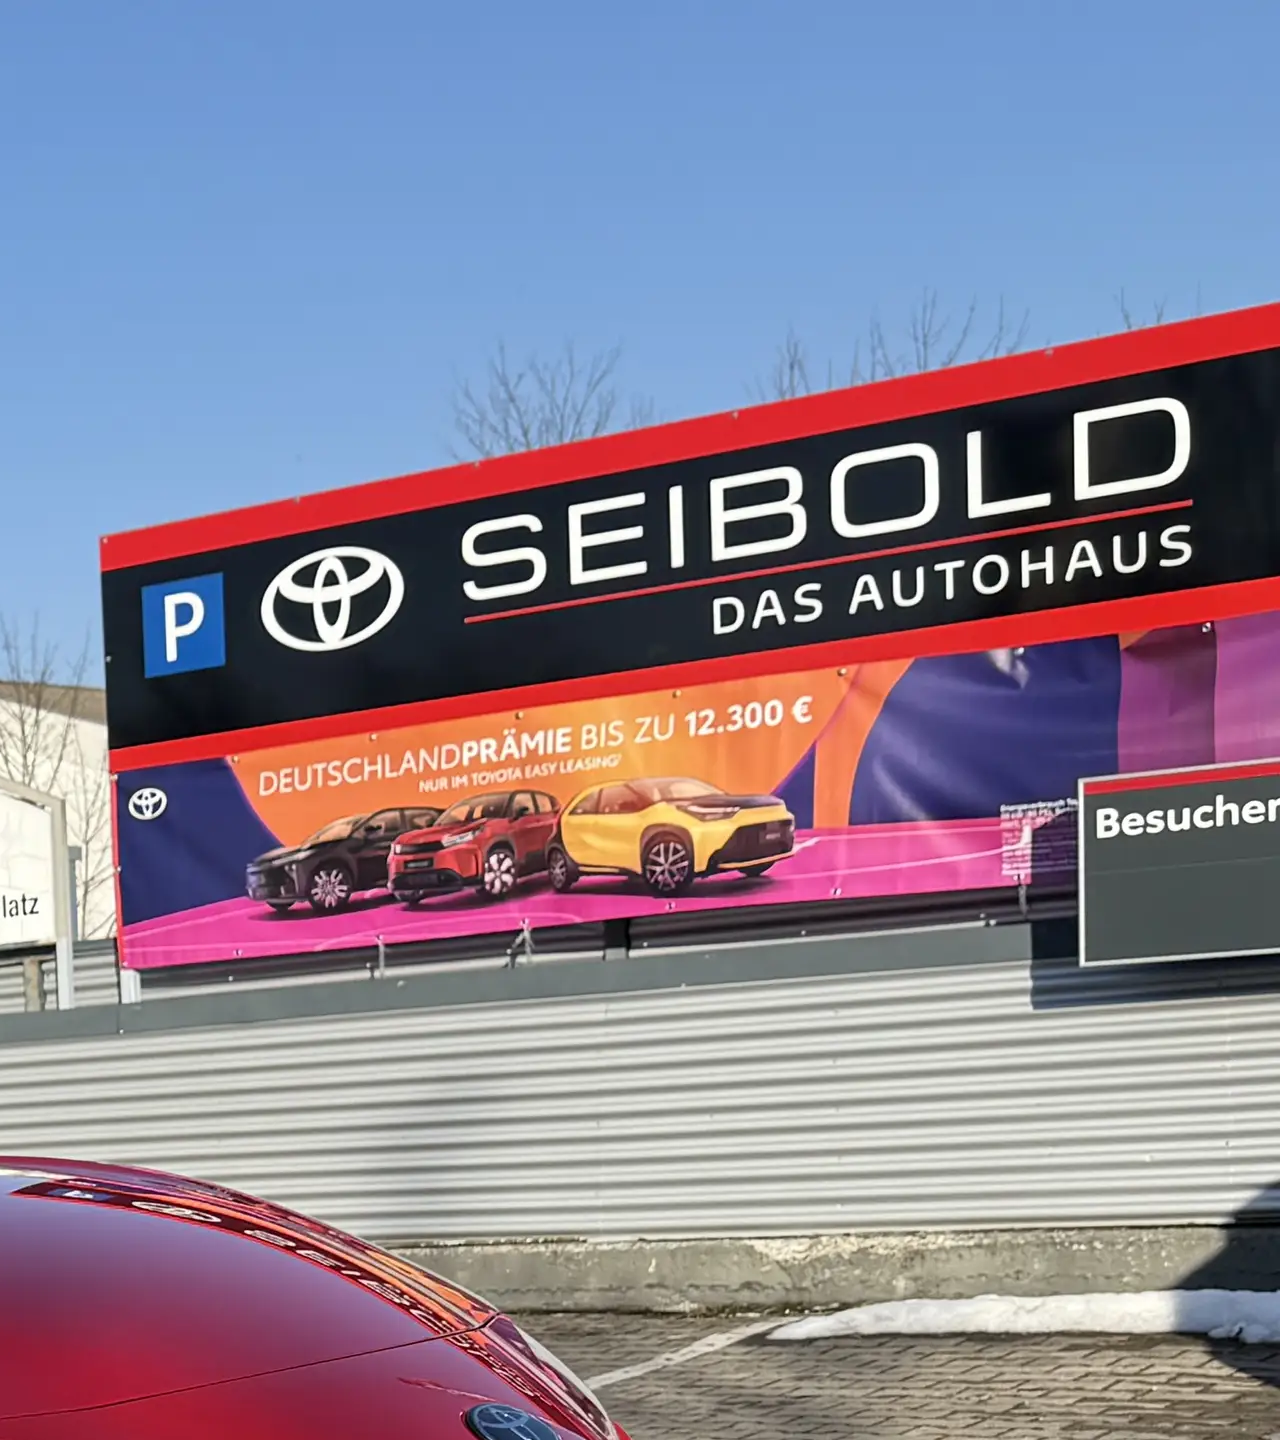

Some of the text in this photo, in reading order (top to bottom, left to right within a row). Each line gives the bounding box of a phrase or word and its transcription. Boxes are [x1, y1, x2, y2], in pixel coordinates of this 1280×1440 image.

[461, 396, 1191, 601] SEIBOLD
[711, 524, 1193, 636] DAS AUTOHAUS
[164, 591, 205, 663] P
[258, 695, 813, 796] DEUTSCHLANDPRÄMIE BIS ZU 12.300 €
[419, 776, 448, 793] NUR
[451, 774, 468, 789] IM
[471, 766, 523, 786] TOYOTA
[524, 759, 558, 779] EASY
[1096, 794, 1280, 839] Besucher
